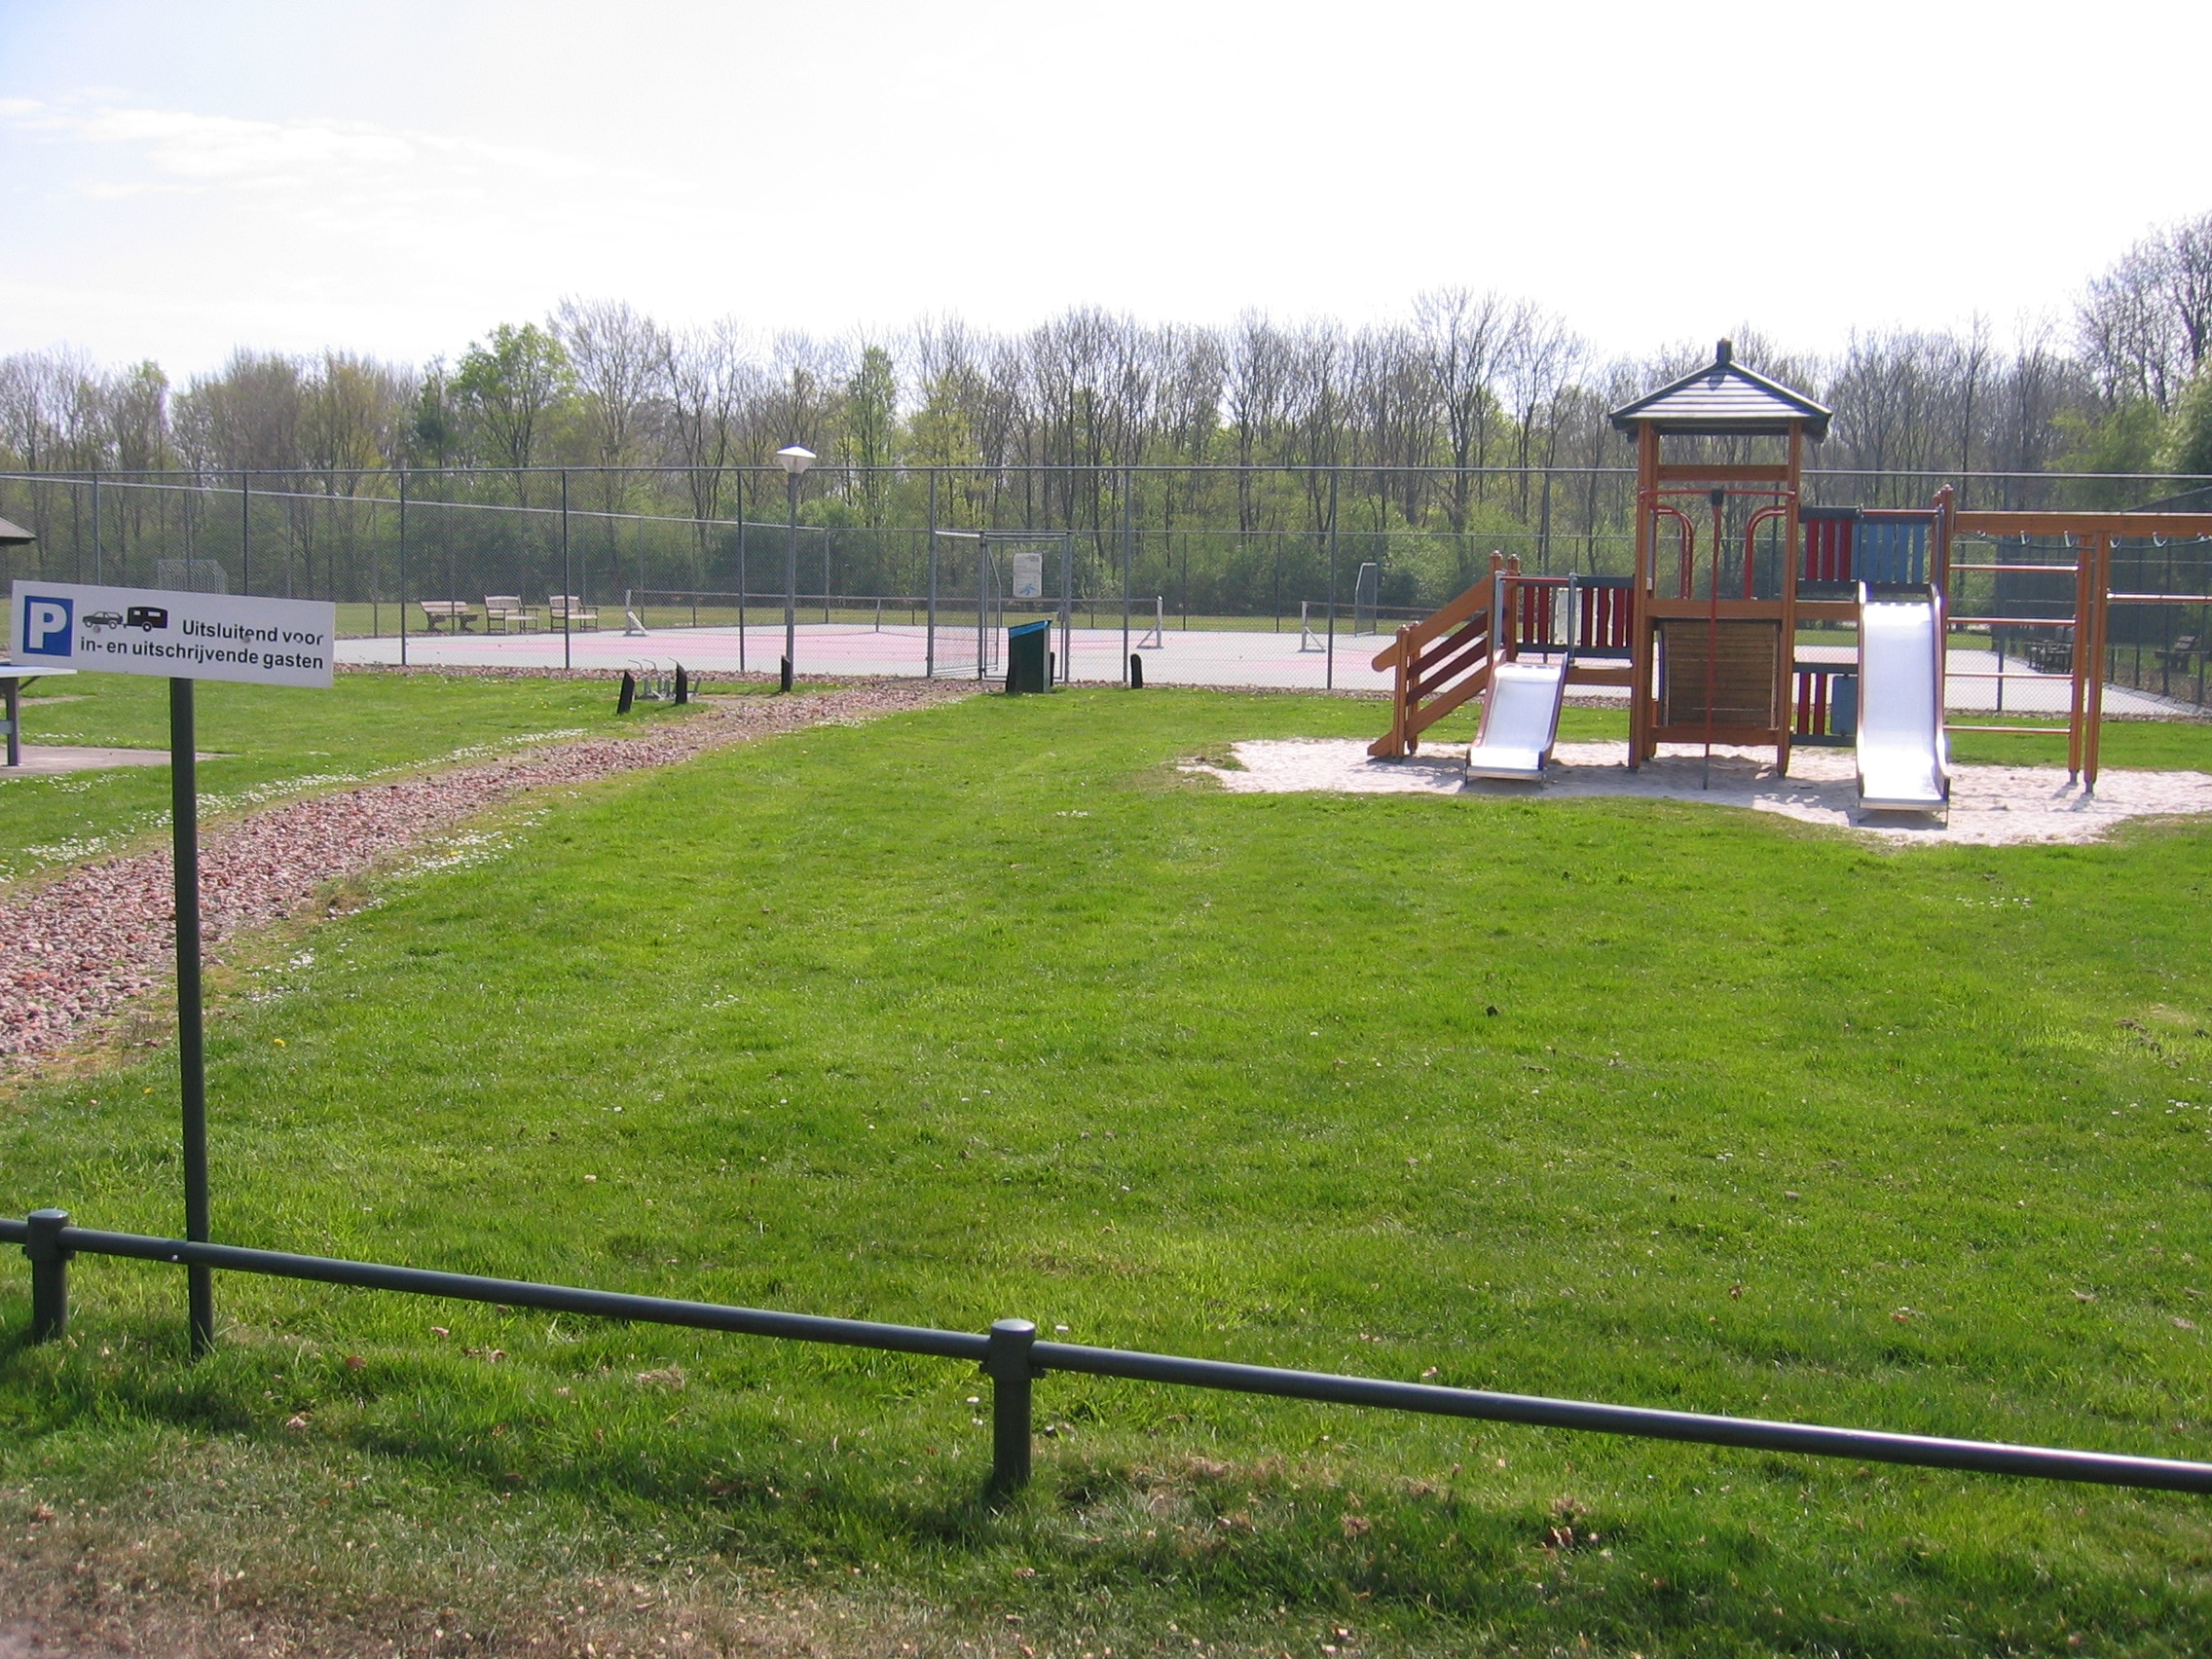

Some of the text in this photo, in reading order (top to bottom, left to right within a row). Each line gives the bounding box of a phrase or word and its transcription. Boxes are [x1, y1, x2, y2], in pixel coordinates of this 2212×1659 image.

[28, 601, 67, 649] P
[182, 619, 324, 645] Uitsluitend voor
[80, 636, 323, 670] in- en uitschrijvende gasten
